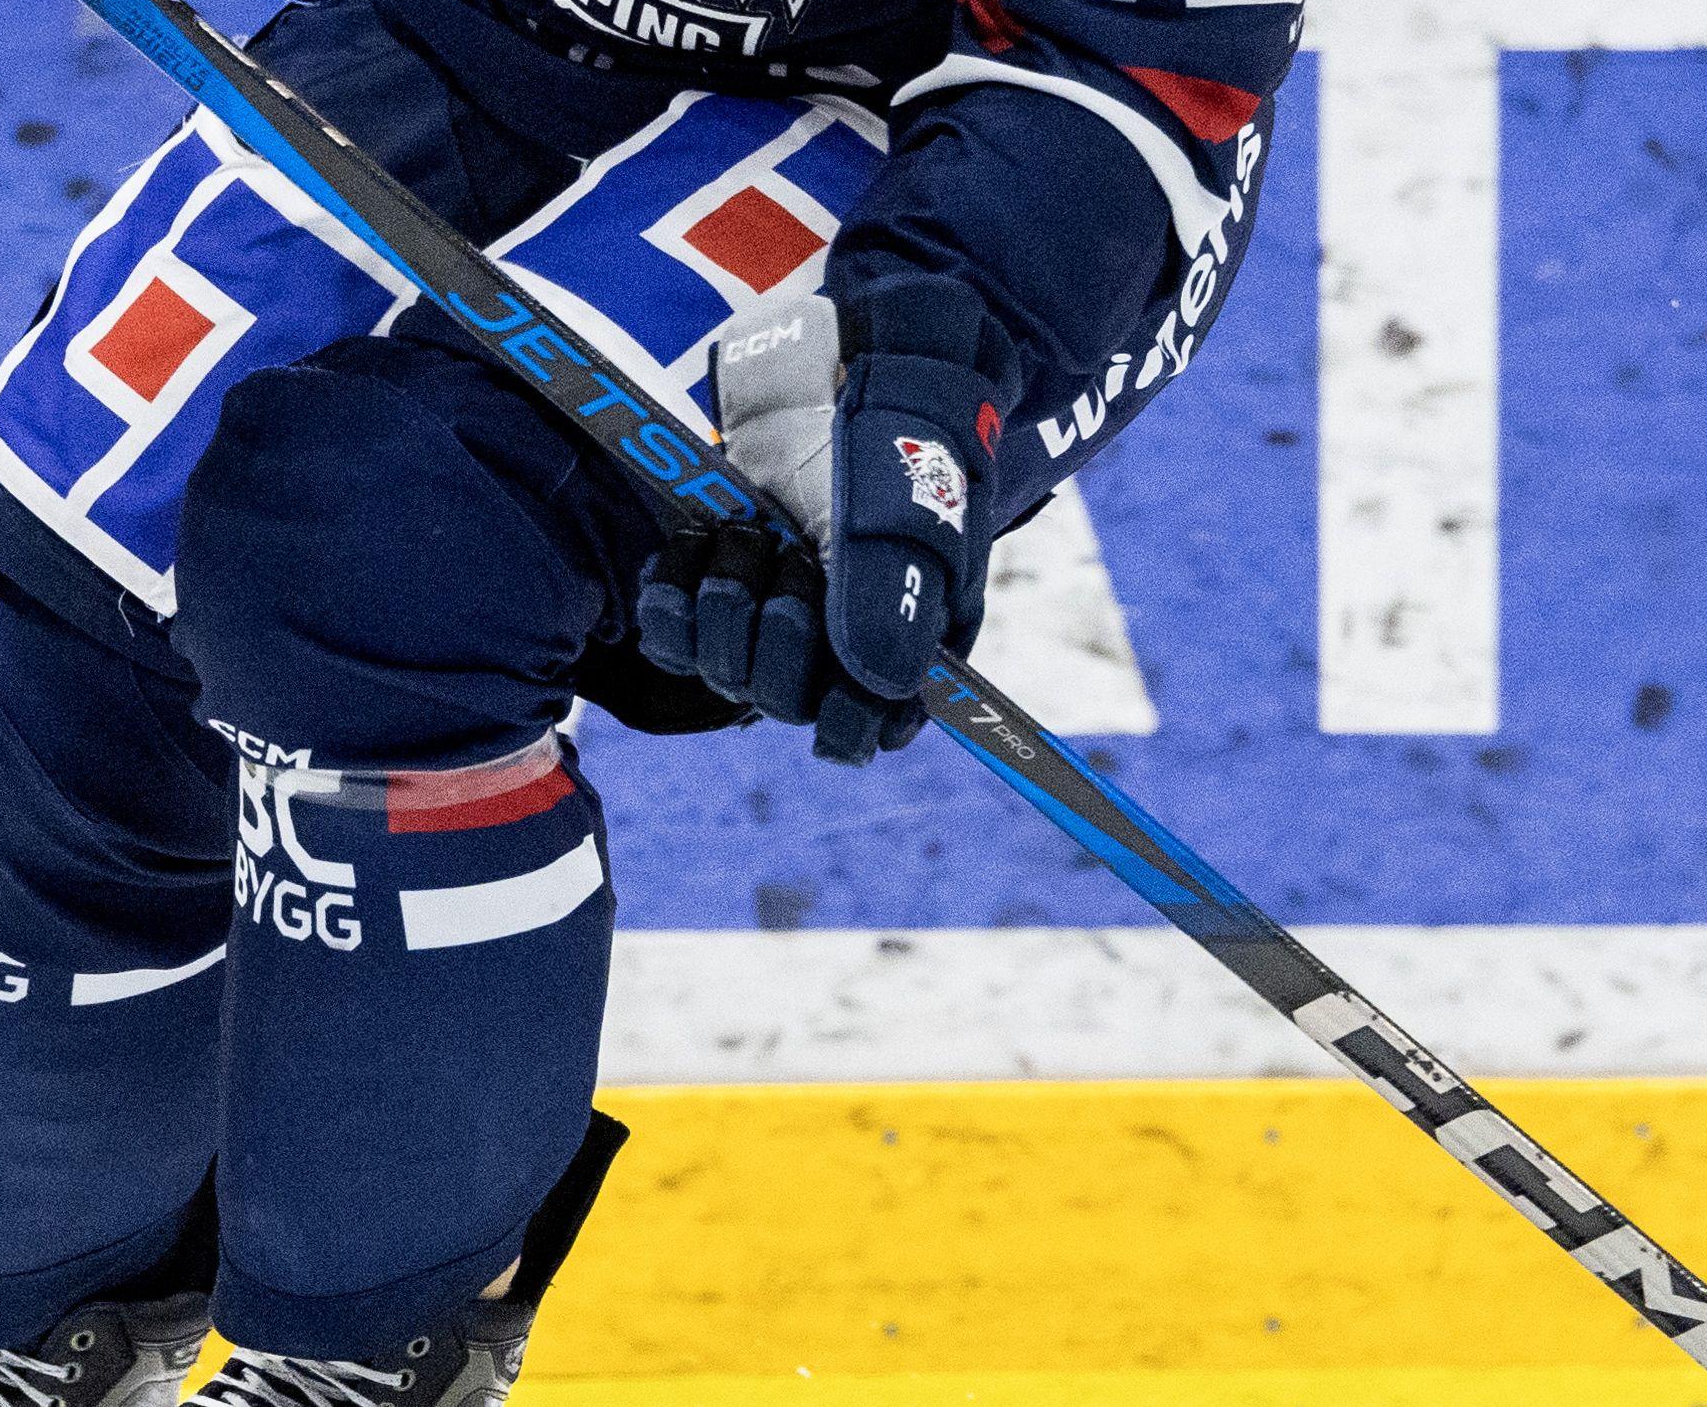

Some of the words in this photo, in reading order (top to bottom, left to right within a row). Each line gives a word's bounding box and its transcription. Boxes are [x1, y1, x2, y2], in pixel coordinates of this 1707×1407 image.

[724, 318, 803, 364] CCM
[208, 718, 312, 769] CCM
[992, 724, 1037, 760] PRO
[234, 839, 363, 952] BYGG
